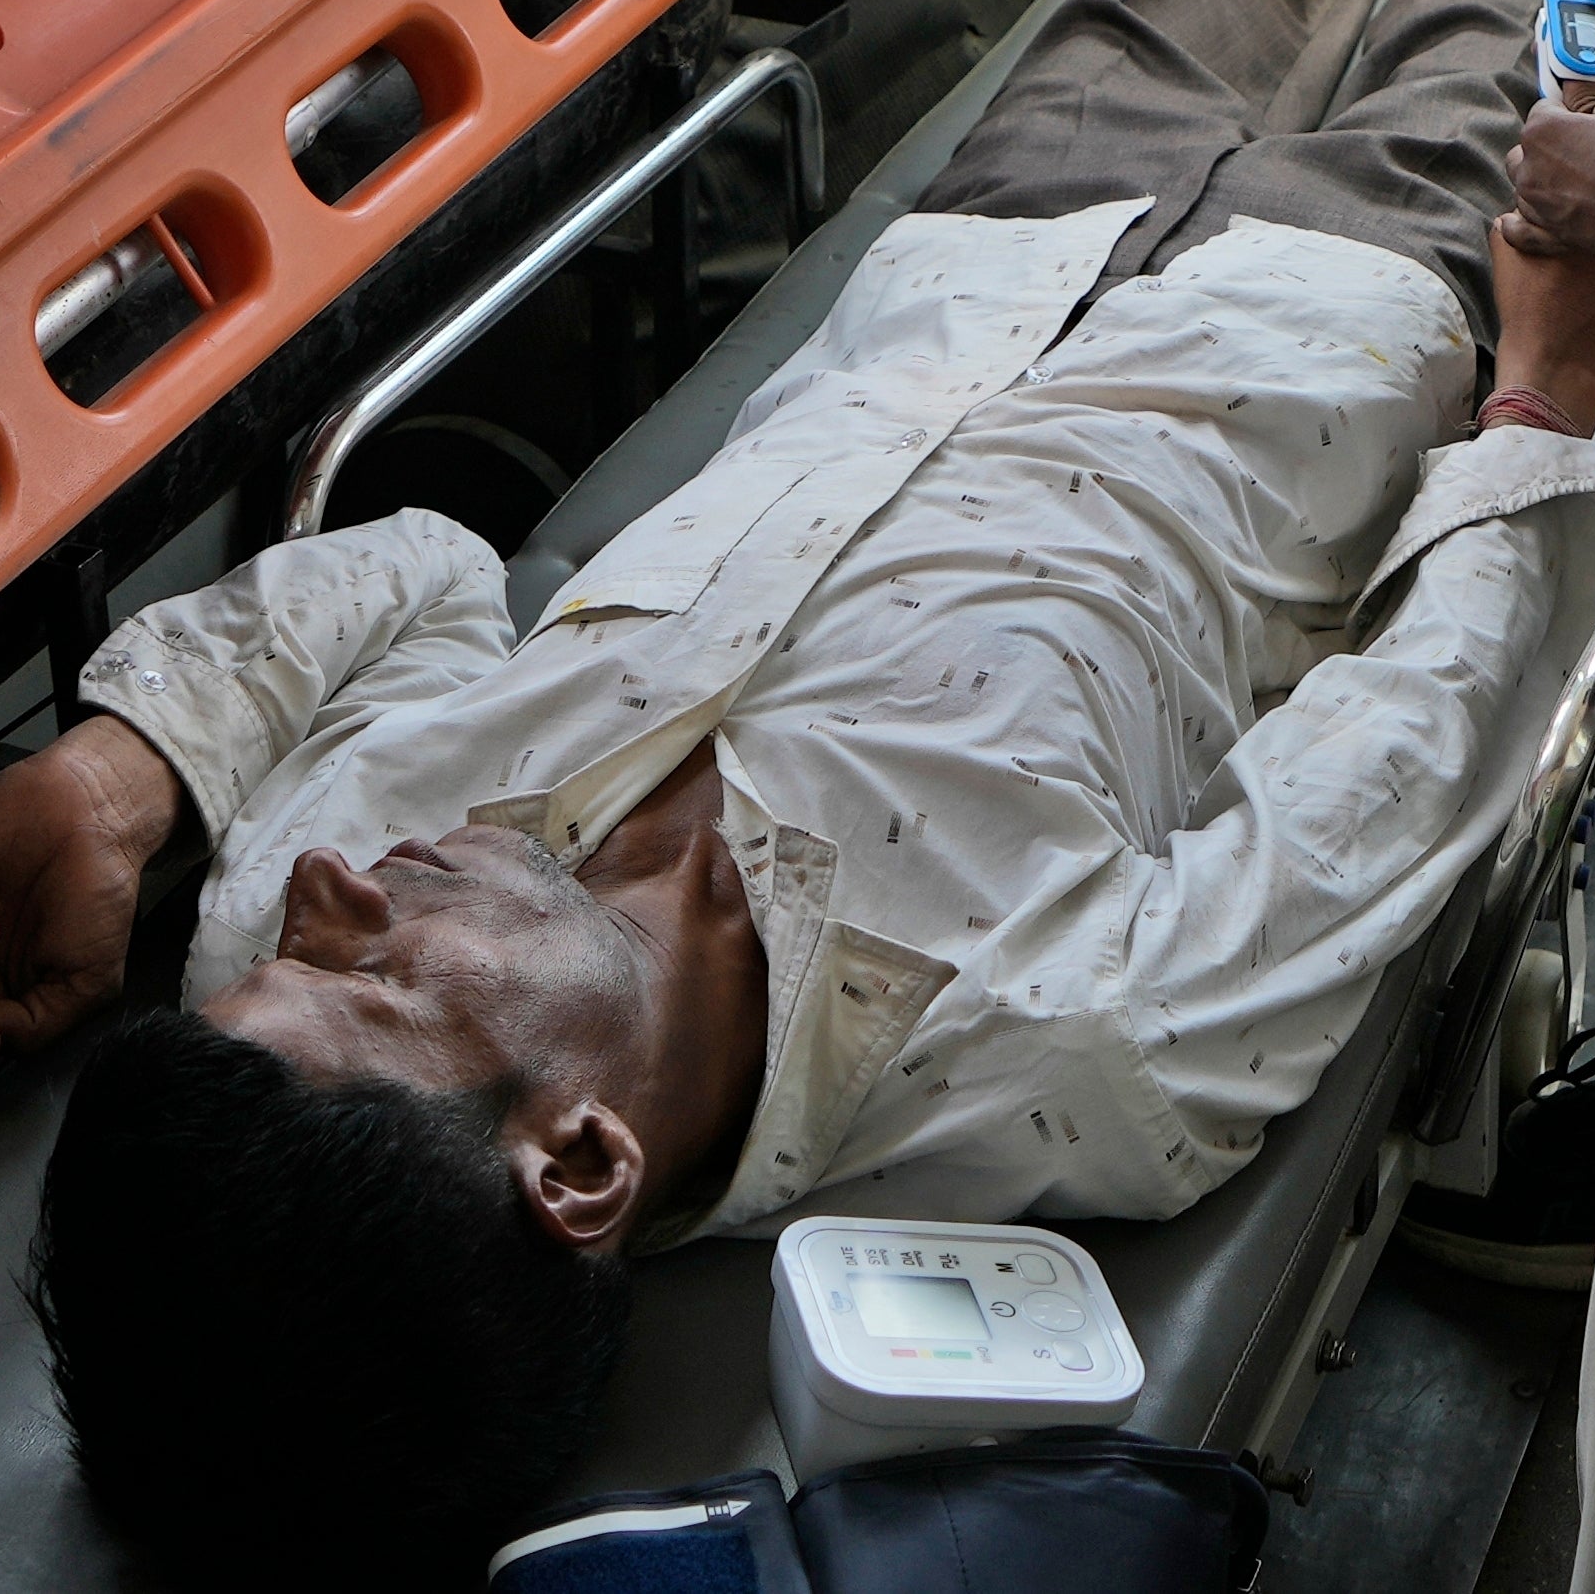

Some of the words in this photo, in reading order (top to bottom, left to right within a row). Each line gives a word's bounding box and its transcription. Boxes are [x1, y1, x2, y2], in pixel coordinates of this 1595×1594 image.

[840, 1246, 858, 1265] DATE
[864, 1248, 880, 1265] SYS
[900, 1251, 915, 1266] DIA
[938, 1253, 955, 1269] PUL
[994, 1262, 1016, 1273] M
[1033, 1349, 1051, 1359] S
